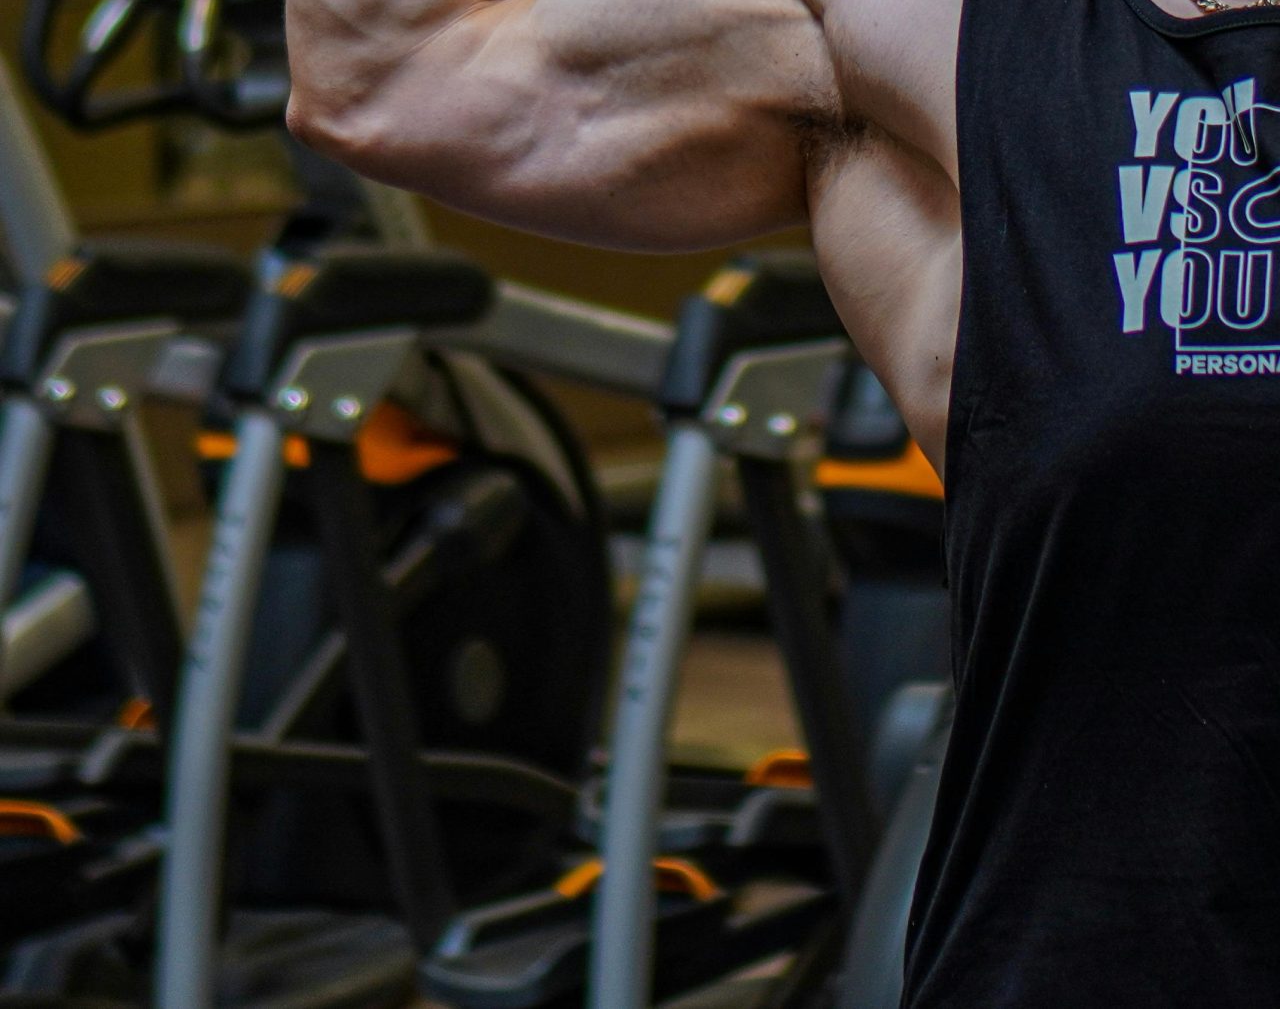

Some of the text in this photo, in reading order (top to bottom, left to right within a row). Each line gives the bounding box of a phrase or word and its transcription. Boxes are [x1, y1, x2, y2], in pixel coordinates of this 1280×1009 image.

[1128, 77, 1257, 166] YOU
[1118, 164, 1223, 244] VS
[1112, 246, 1272, 334] YOU
